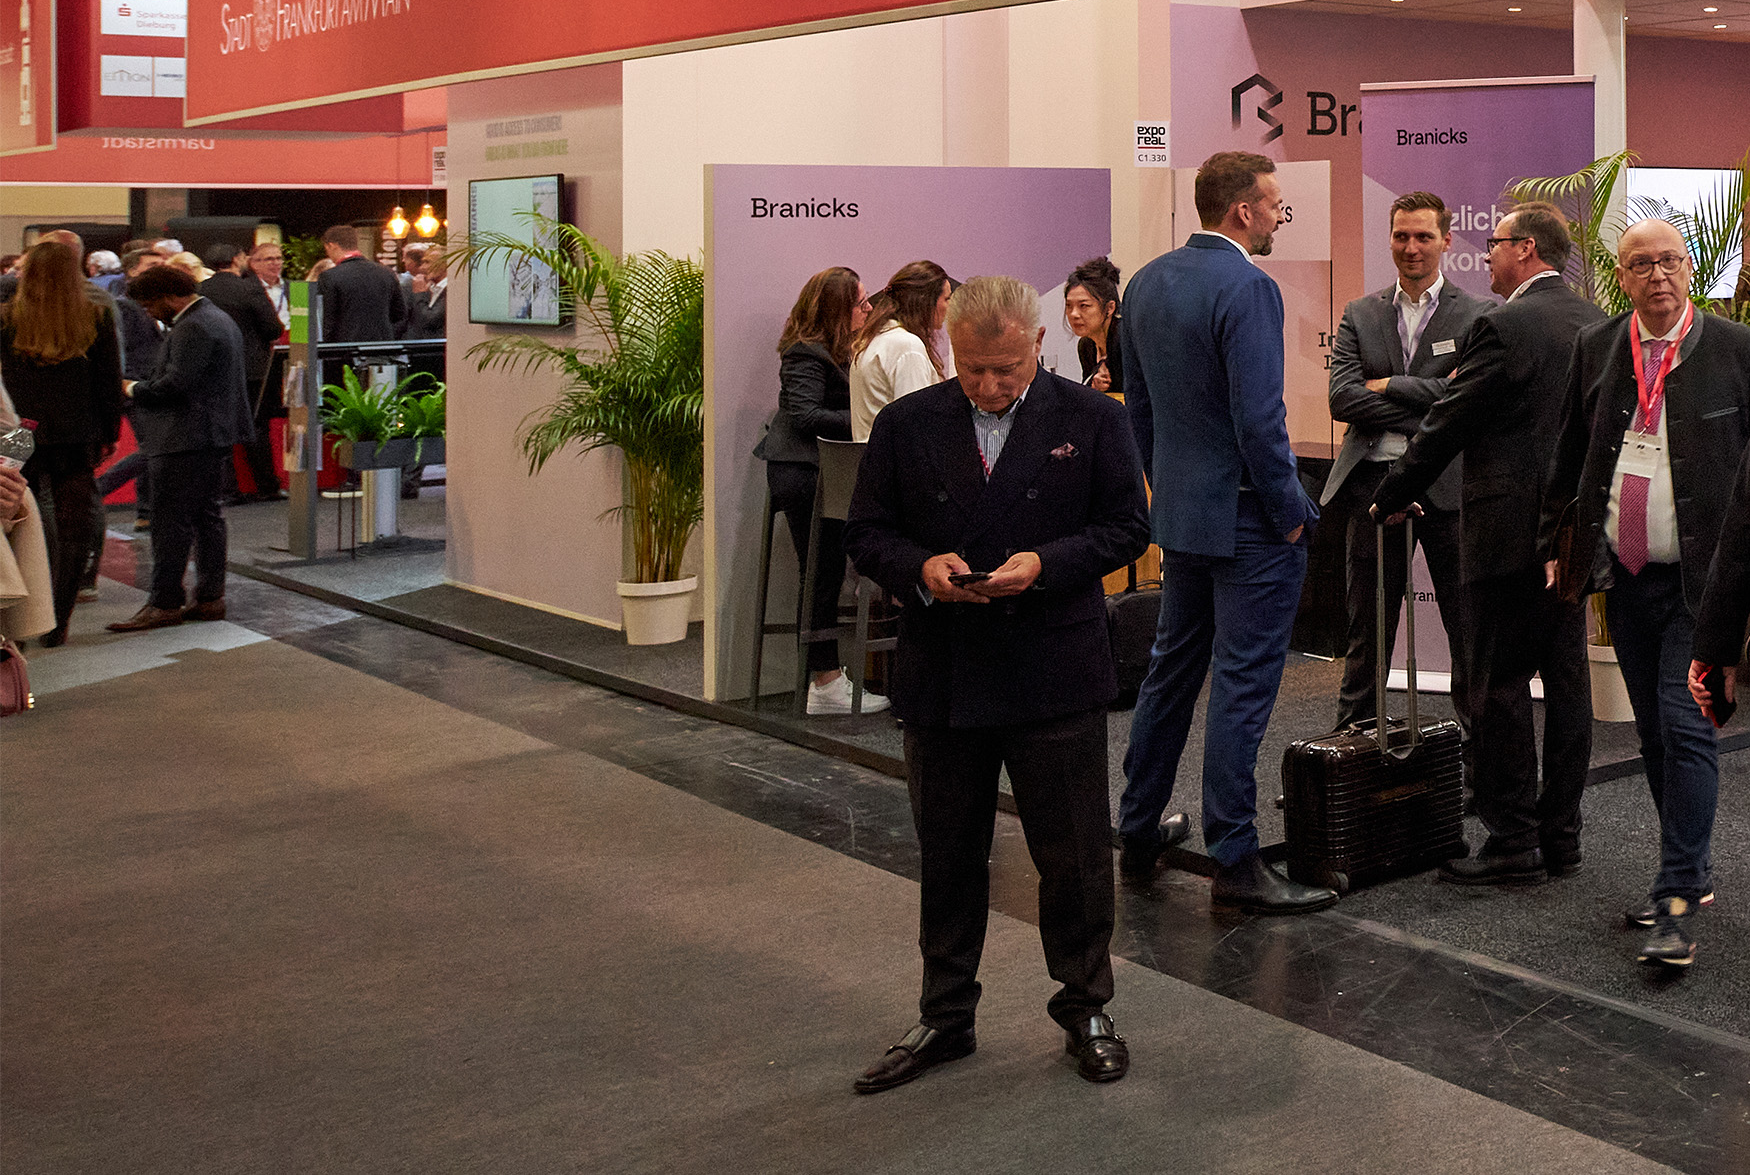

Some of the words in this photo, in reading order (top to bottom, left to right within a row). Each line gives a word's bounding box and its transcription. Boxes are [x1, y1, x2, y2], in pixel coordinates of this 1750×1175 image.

[220, 3, 253, 54] STADT
[1306, 92, 1362, 136] Br
[1137, 126, 1165, 140] expo
[1397, 128, 1468, 145] Branicks
[751, 197, 859, 218] Branicks
[1450, 204, 1504, 231] zlich
